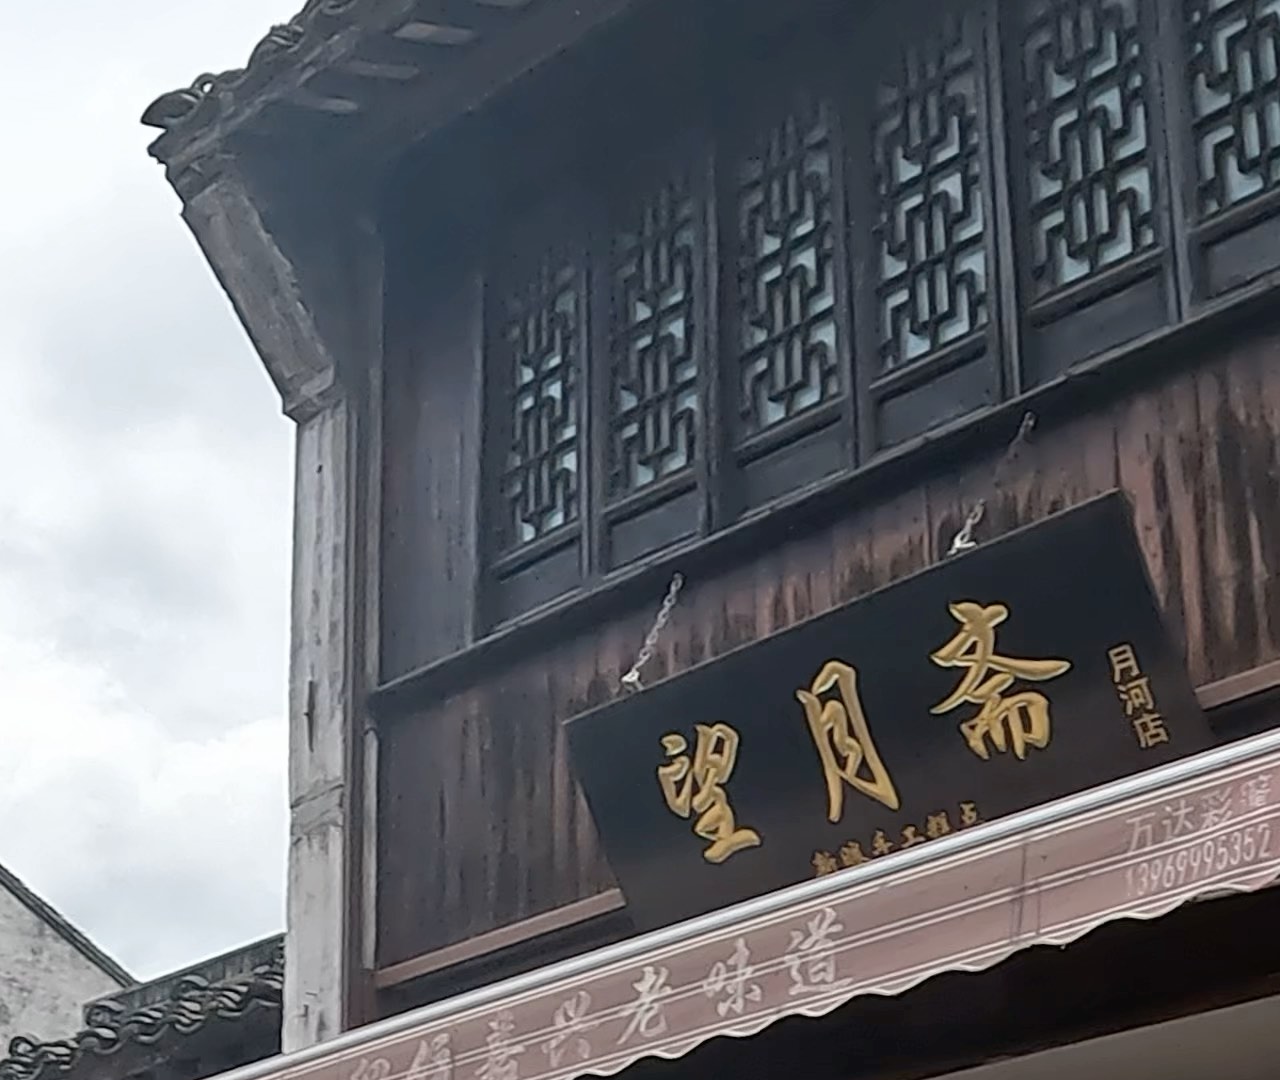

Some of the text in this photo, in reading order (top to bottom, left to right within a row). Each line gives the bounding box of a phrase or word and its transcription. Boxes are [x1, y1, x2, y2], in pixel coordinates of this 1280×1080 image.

[658, 602, 1071, 864] 望月斋
[1107, 643, 1169, 748] 月河店
